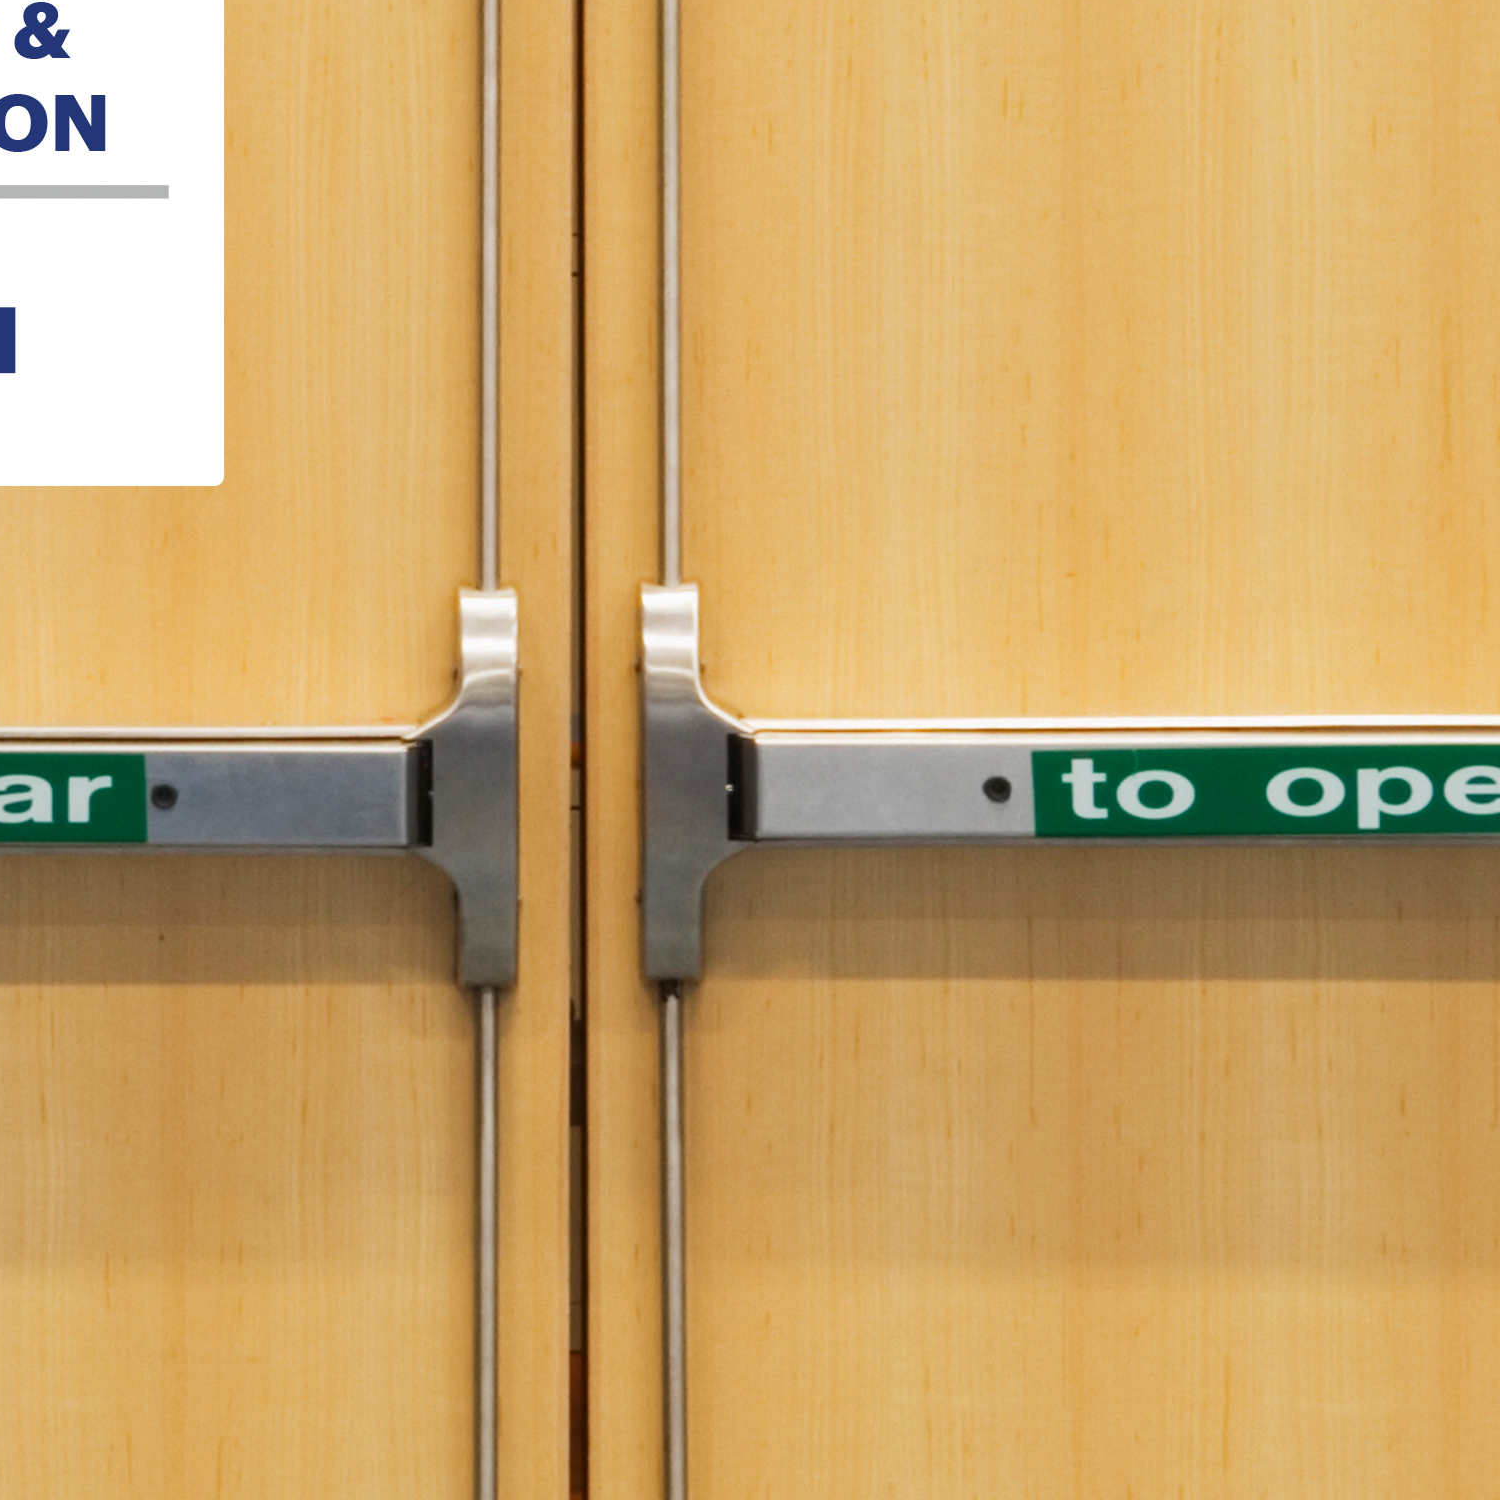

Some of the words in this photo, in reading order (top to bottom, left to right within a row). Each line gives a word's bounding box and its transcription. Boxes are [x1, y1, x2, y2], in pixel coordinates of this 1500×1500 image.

[14, 1, 71, 60] &
[1061, 758, 1196, 819] to
[1266, 765, 1500, 830] ope
